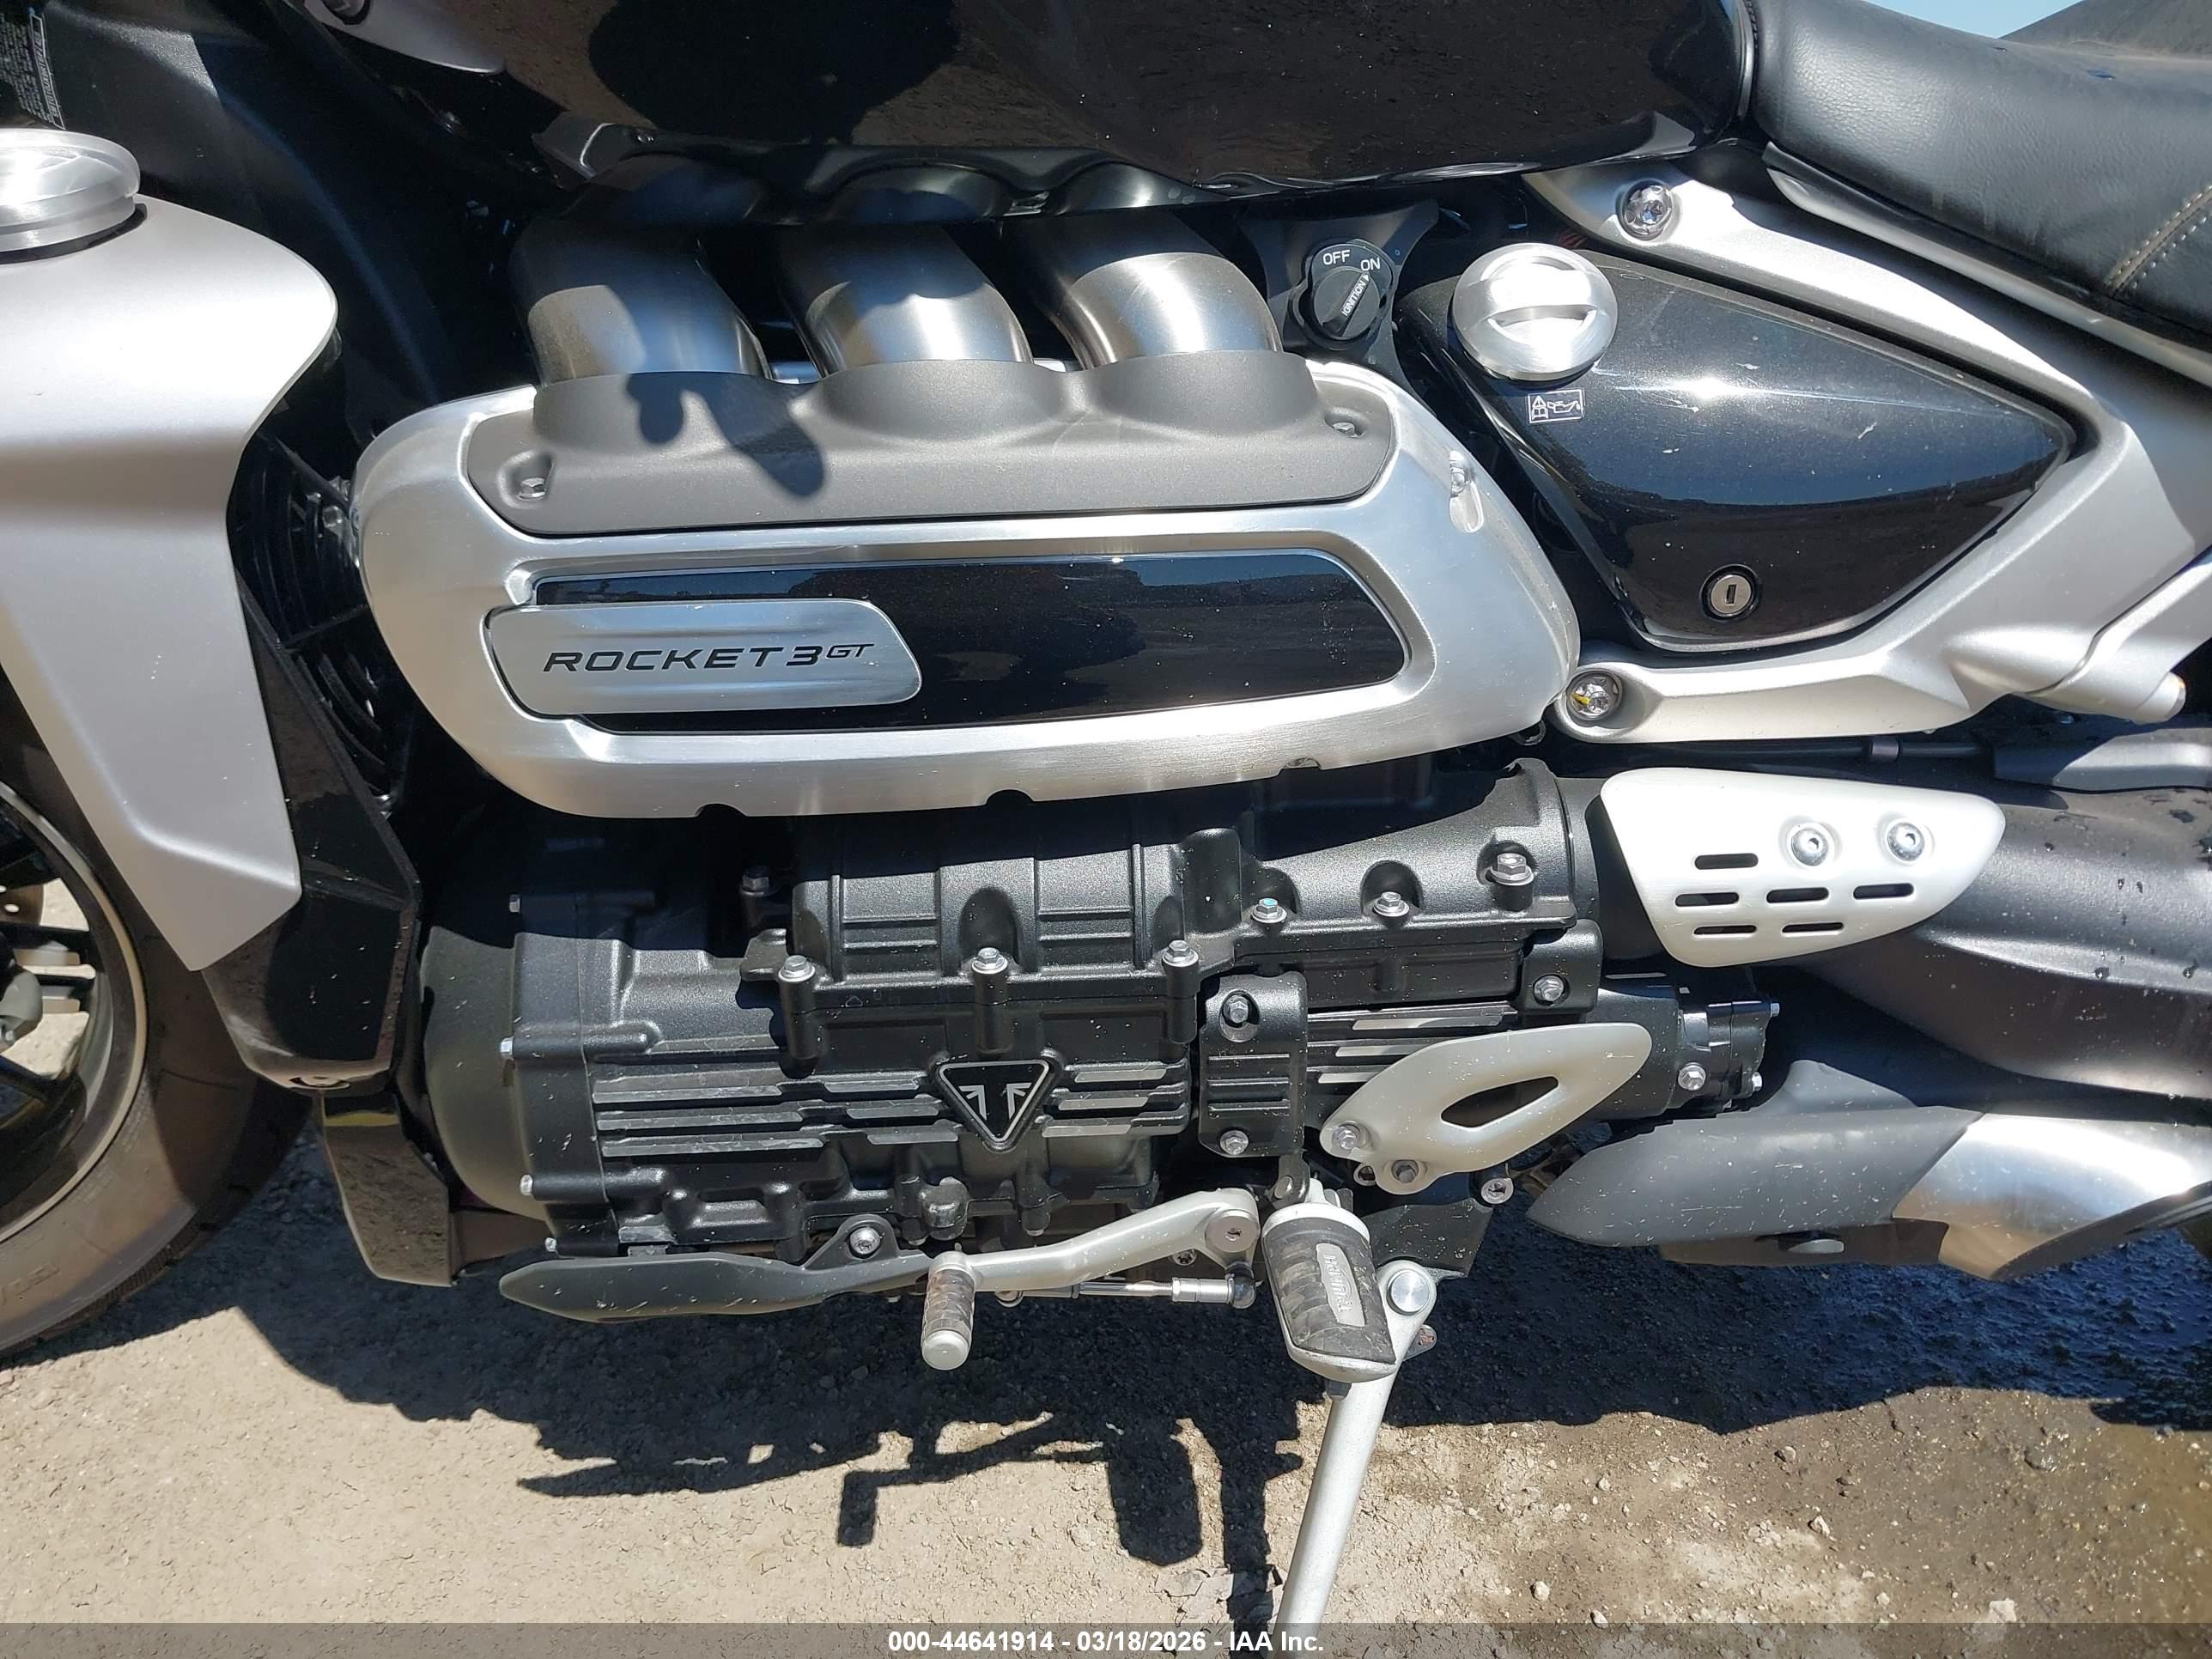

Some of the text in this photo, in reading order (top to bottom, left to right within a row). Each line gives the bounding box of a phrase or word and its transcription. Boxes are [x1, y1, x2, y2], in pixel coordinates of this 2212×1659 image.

[1322, 249, 1351, 265] OFF
[1360, 257, 1381, 271] ON
[1340, 280, 1366, 317] IGNITION
[543, 647, 784, 672] ROCKET
[1324, 1255, 1353, 1311] TRIUMPH
